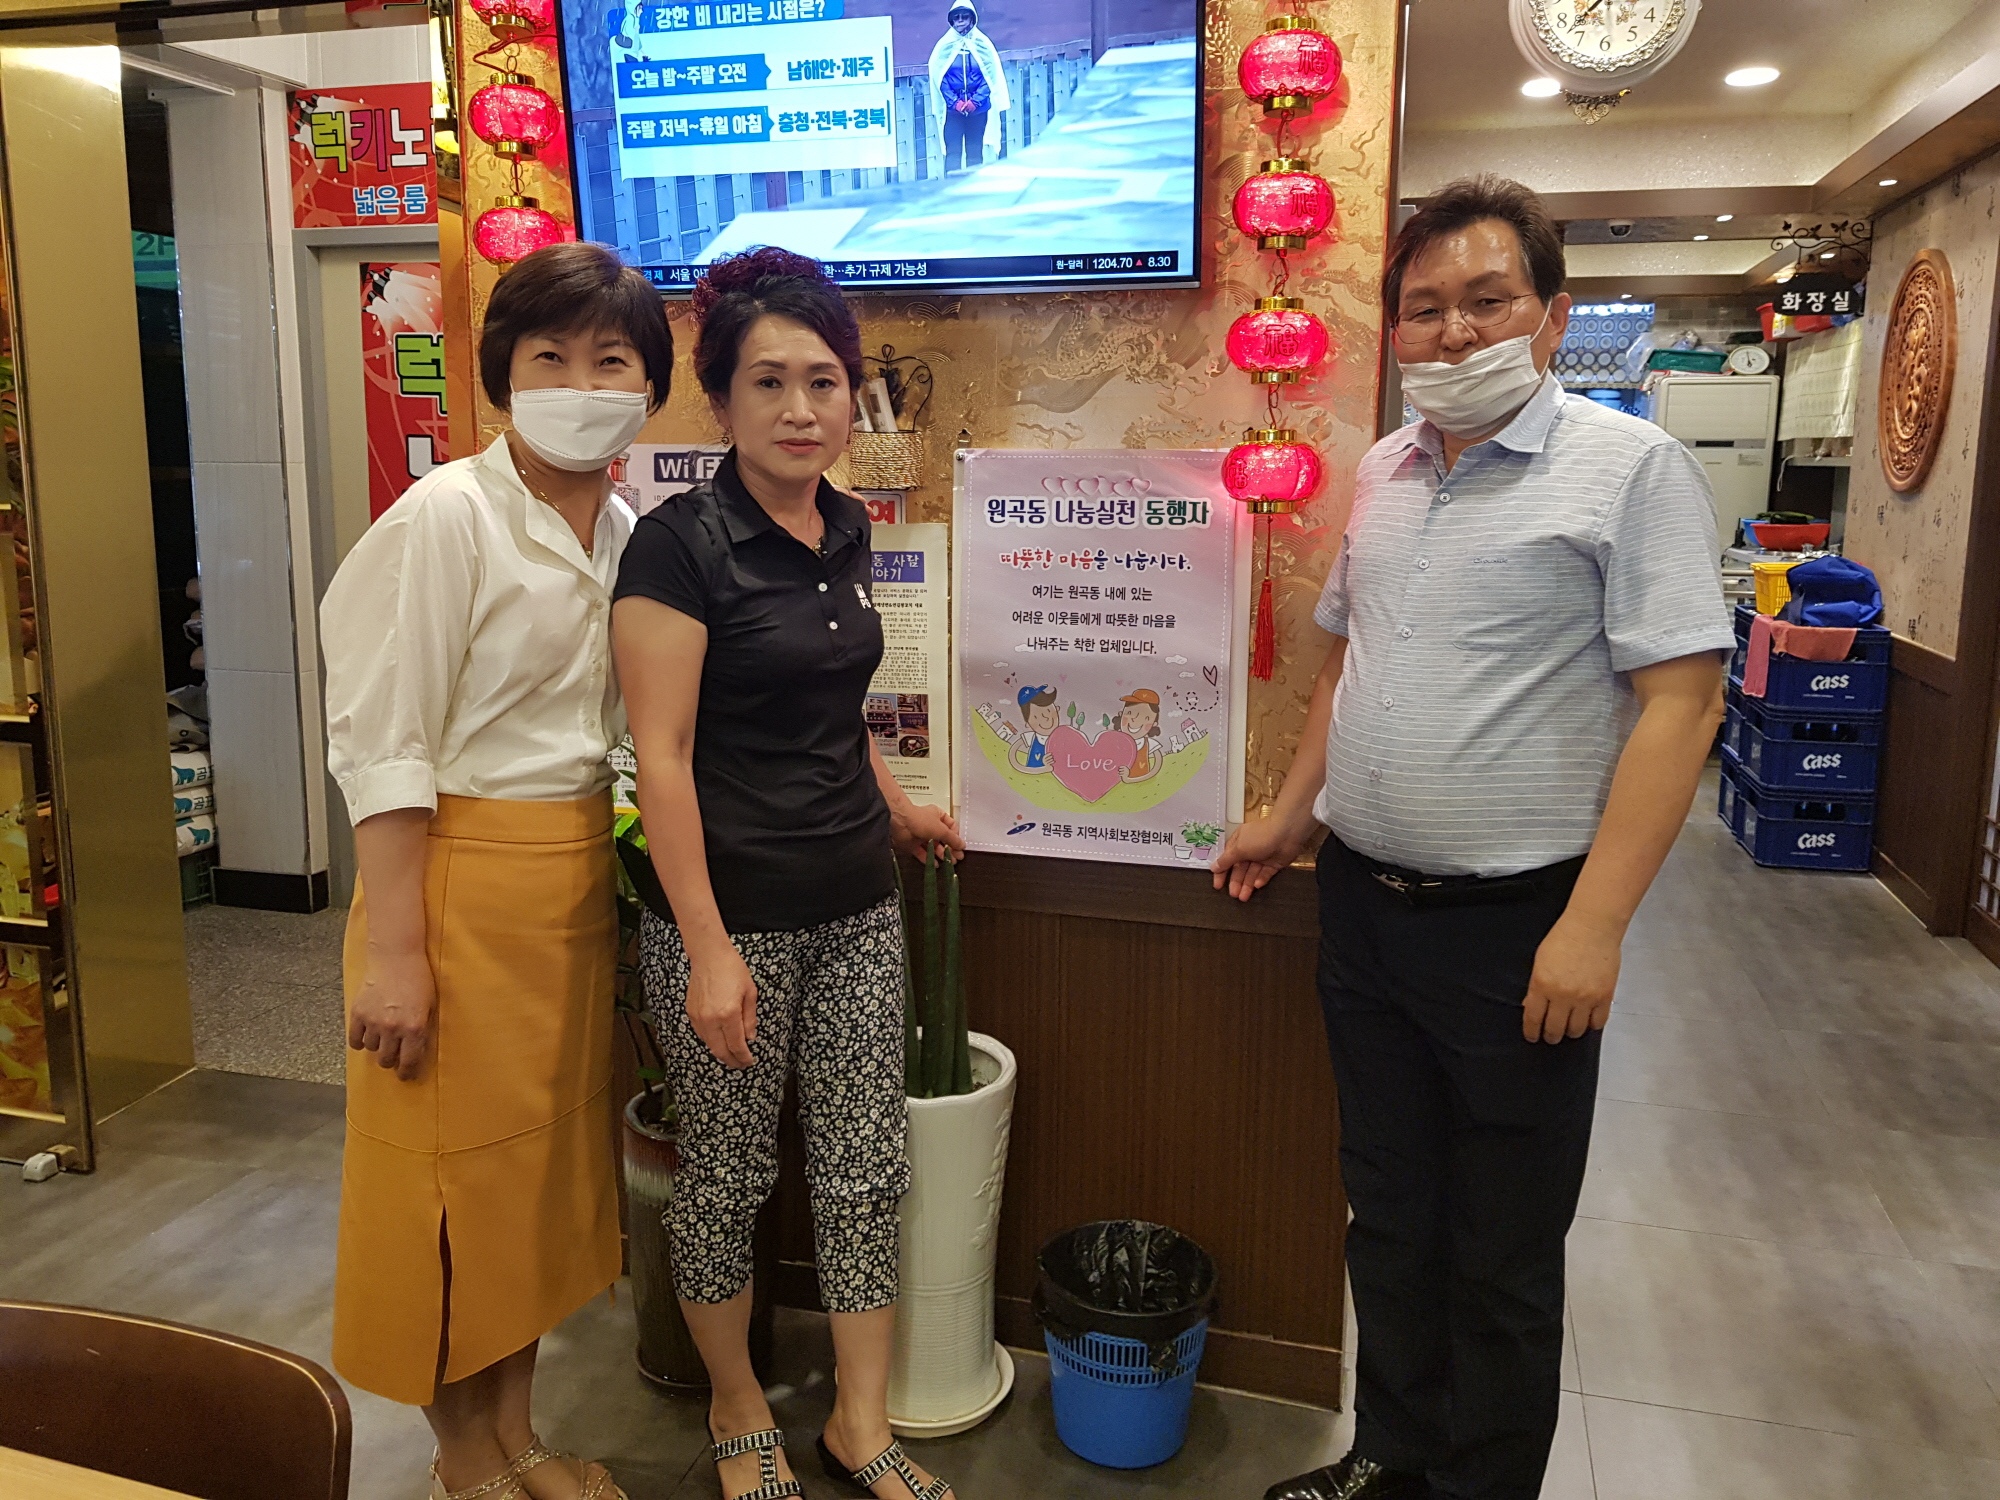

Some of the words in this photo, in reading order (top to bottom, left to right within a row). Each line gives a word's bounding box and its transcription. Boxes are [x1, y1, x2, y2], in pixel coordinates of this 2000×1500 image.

[655, 7, 689, 29] 강한
[695, 6, 711, 27] 비
[716, 2, 762, 26] 내리는
[767, 0, 826, 21] 시점은?
[1556, 12, 1568, 29] 8
[1644, 7, 1656, 23] 4
[1574, 30, 1586, 47] 7
[1599, 34, 1612, 51] 6
[1626, 25, 1639, 42] 5
[631, 69, 659, 89] 오늘
[718, 62, 747, 84] 오전
[626, 119, 656, 140] 주말
[732, 113, 762, 134] 아침
[354, 186, 401, 216] 넓은
[402, 184, 428, 215] 룸
[869, 264, 892, 278] 규제
[894, 261, 928, 277] 가능성
[1092, 257, 1133, 269] 1204.70
[1148, 256, 1171, 267] 8.30
[669, 268, 691, 282] 서울
[1781, 290, 1850, 313] 화장실
[988, 498, 1047, 525] 원곡동
[1055, 499, 1136, 526] 나눔실천
[1145, 499, 1209, 526] 동행자
[892, 554, 920, 569] 사람
[1000, 548, 1054, 570] 따뜻한
[1060, 549, 1108, 570] 마음을
[1114, 551, 1191, 571] 나눕시다.
[1032, 584, 1064, 600] 여기는
[1068, 585, 1100, 601] 원곡동
[1104, 586, 1127, 601] 내에
[1130, 586, 1153, 602] 있는
[1012, 610, 1044, 626] 어려운
[1048, 611, 1101, 627] 이웃들에게
[1105, 612, 1139, 628] 따뜻한
[1142, 613, 1177, 629] 마음을
[1027, 636, 1069, 652] 나눠주는
[1073, 637, 1096, 653] 착한
[1099, 638, 1158, 655] 업체입니다.
[1066, 753, 1118, 772] Love
[1041, 822, 1074, 839] 원곡동
[1076, 824, 1175, 847] 지역사회보장협의체
